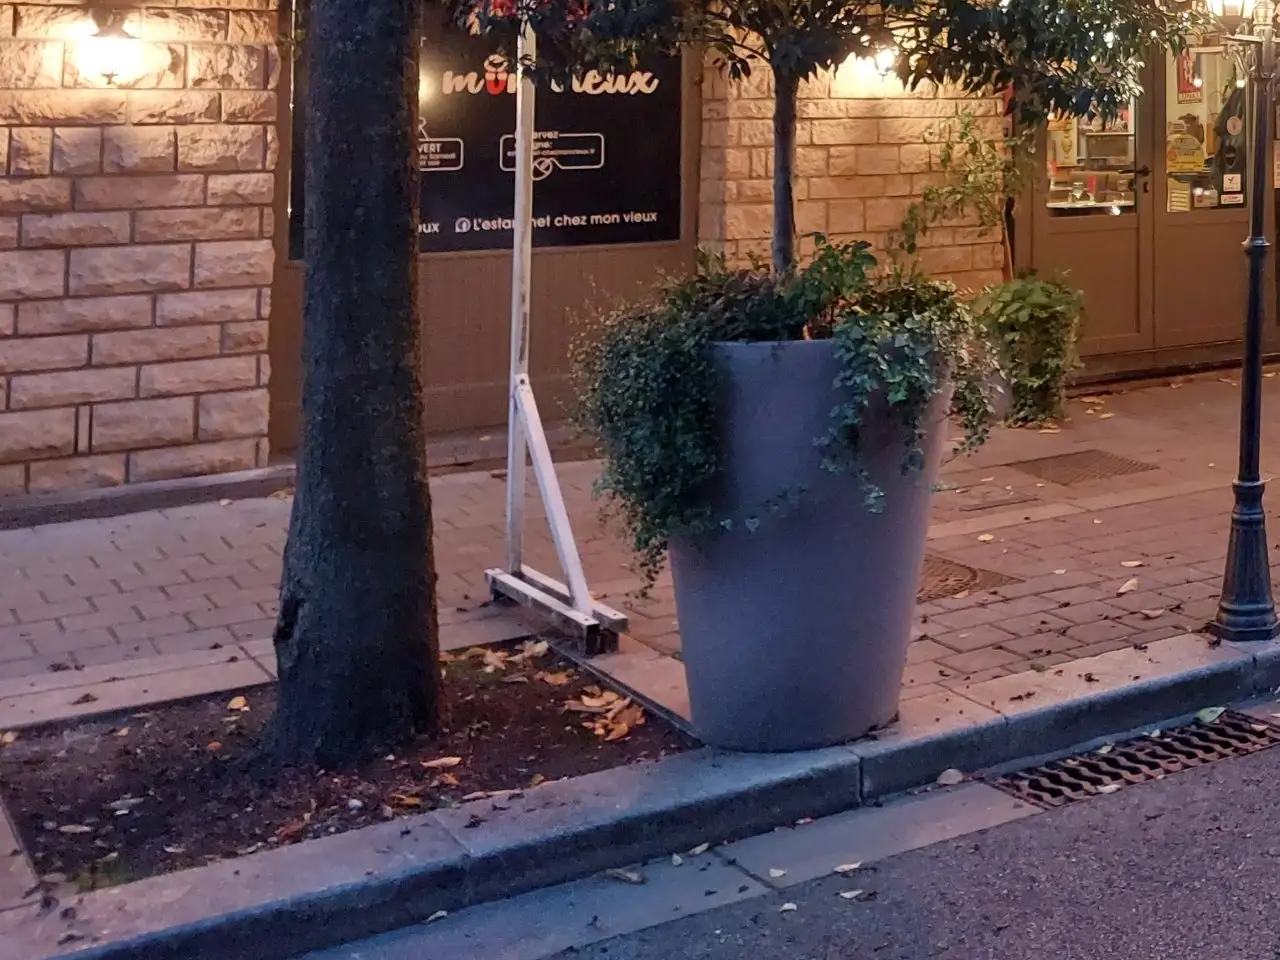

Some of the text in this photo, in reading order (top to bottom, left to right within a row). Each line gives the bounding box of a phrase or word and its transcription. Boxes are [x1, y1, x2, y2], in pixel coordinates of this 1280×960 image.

[554, 216, 587, 227] chez
[590, 214, 619, 225] mon
[622, 211, 657, 223] vieux
